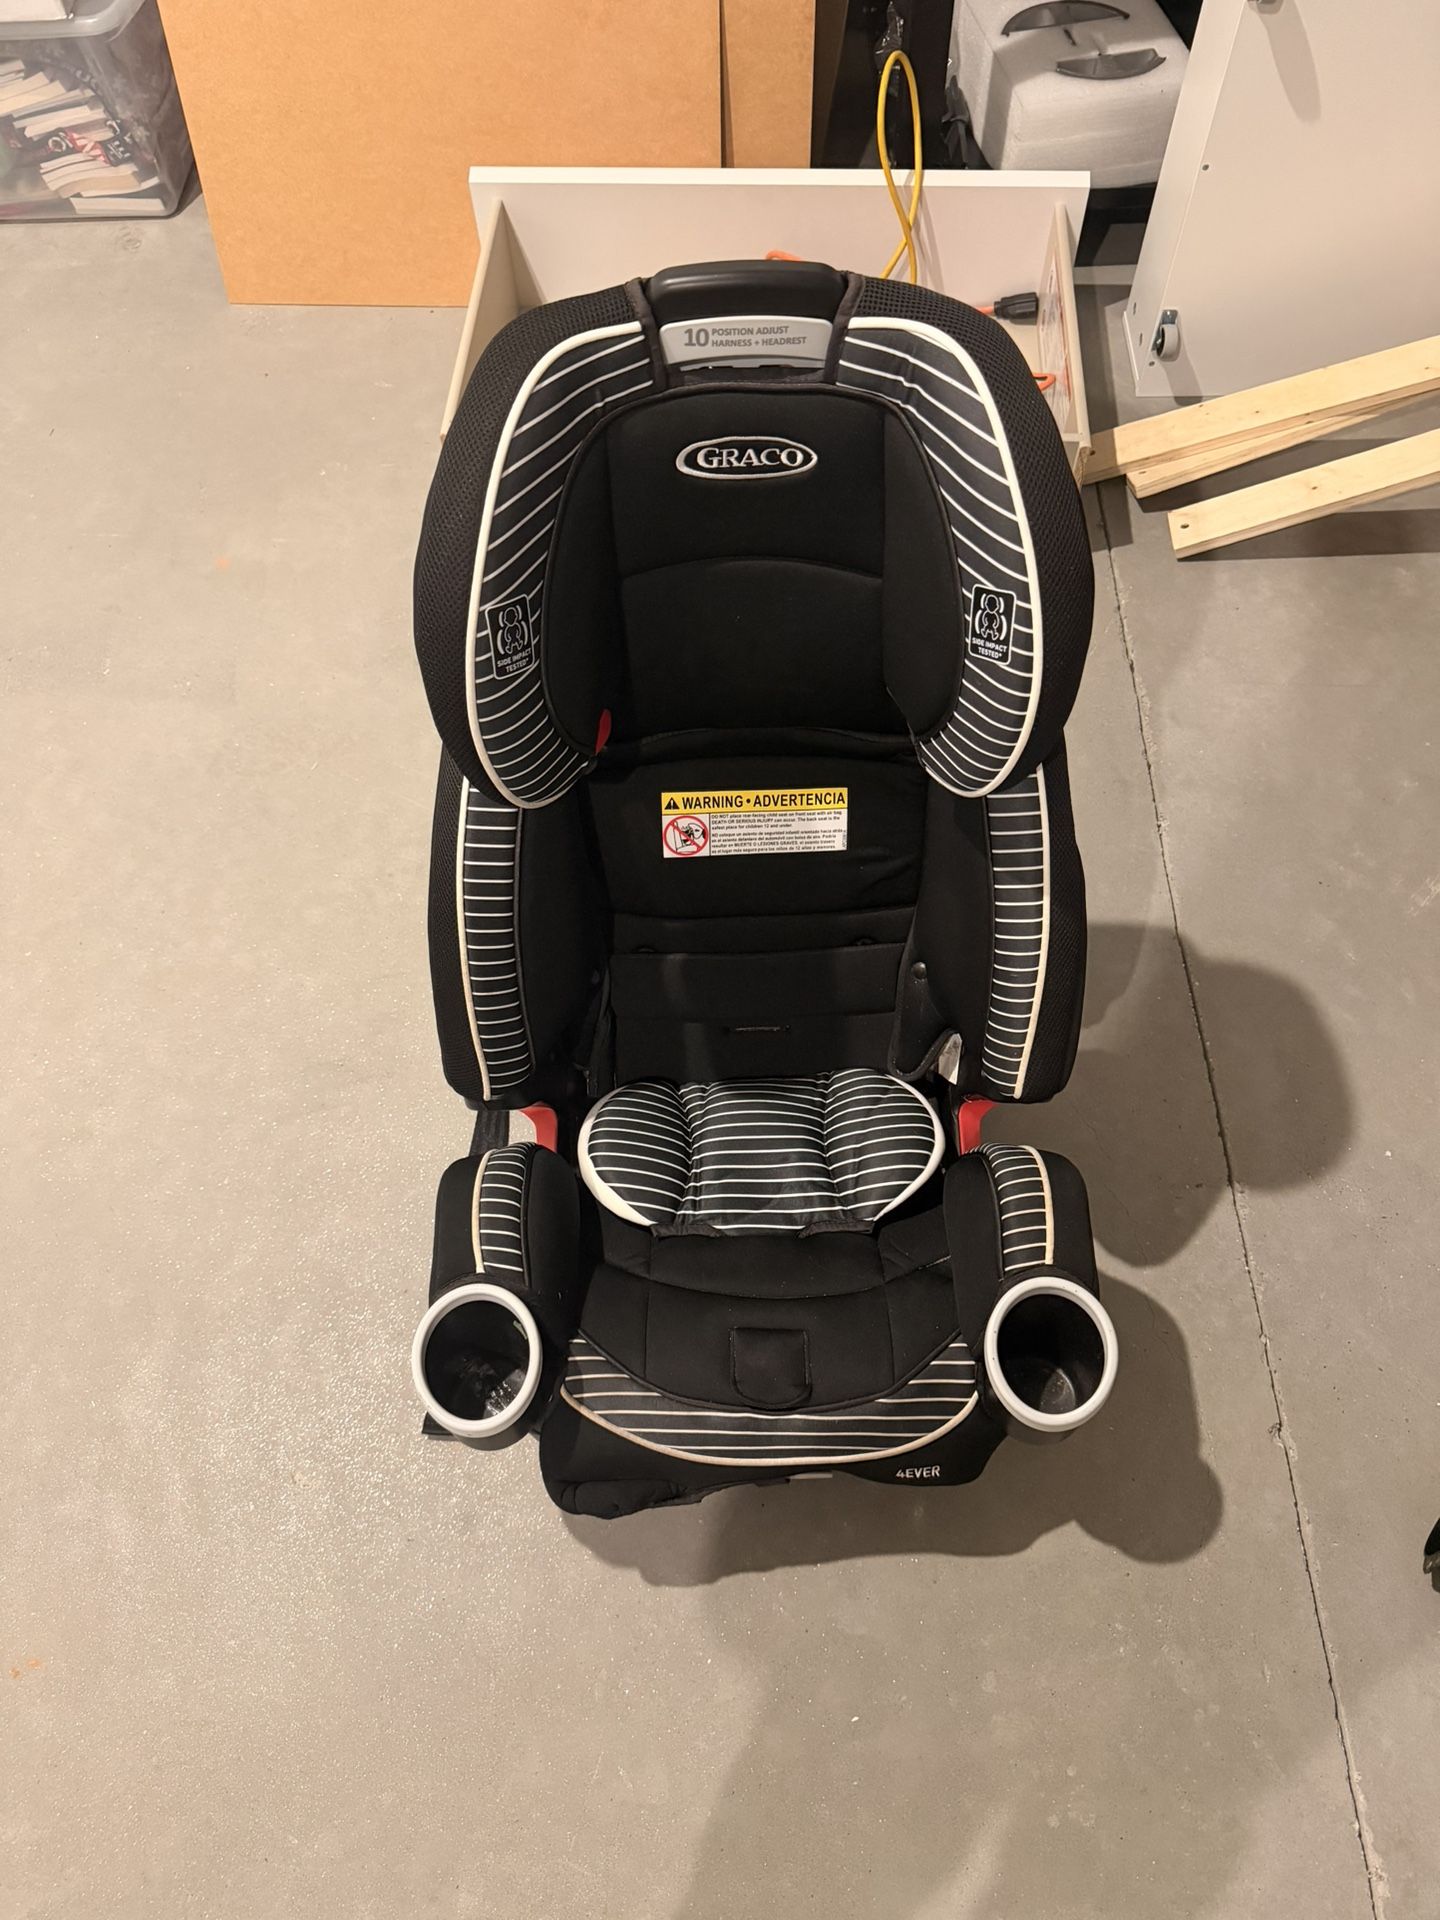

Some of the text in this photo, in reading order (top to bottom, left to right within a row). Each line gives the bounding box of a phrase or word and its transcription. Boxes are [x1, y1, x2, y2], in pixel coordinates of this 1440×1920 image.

[684, 328, 710, 347] 10
[711, 326, 790, 336] POSITION ADJUST
[711, 338, 752, 348] HARNESS
[761, 336, 807, 346] HEADREST
[696, 447, 804, 468] GRACO
[972, 637, 1007, 652] SIDE IMPACT
[682, 792, 846, 810] WARNING ADVERTENCIA
[896, 1464, 940, 1478] 4EVER
